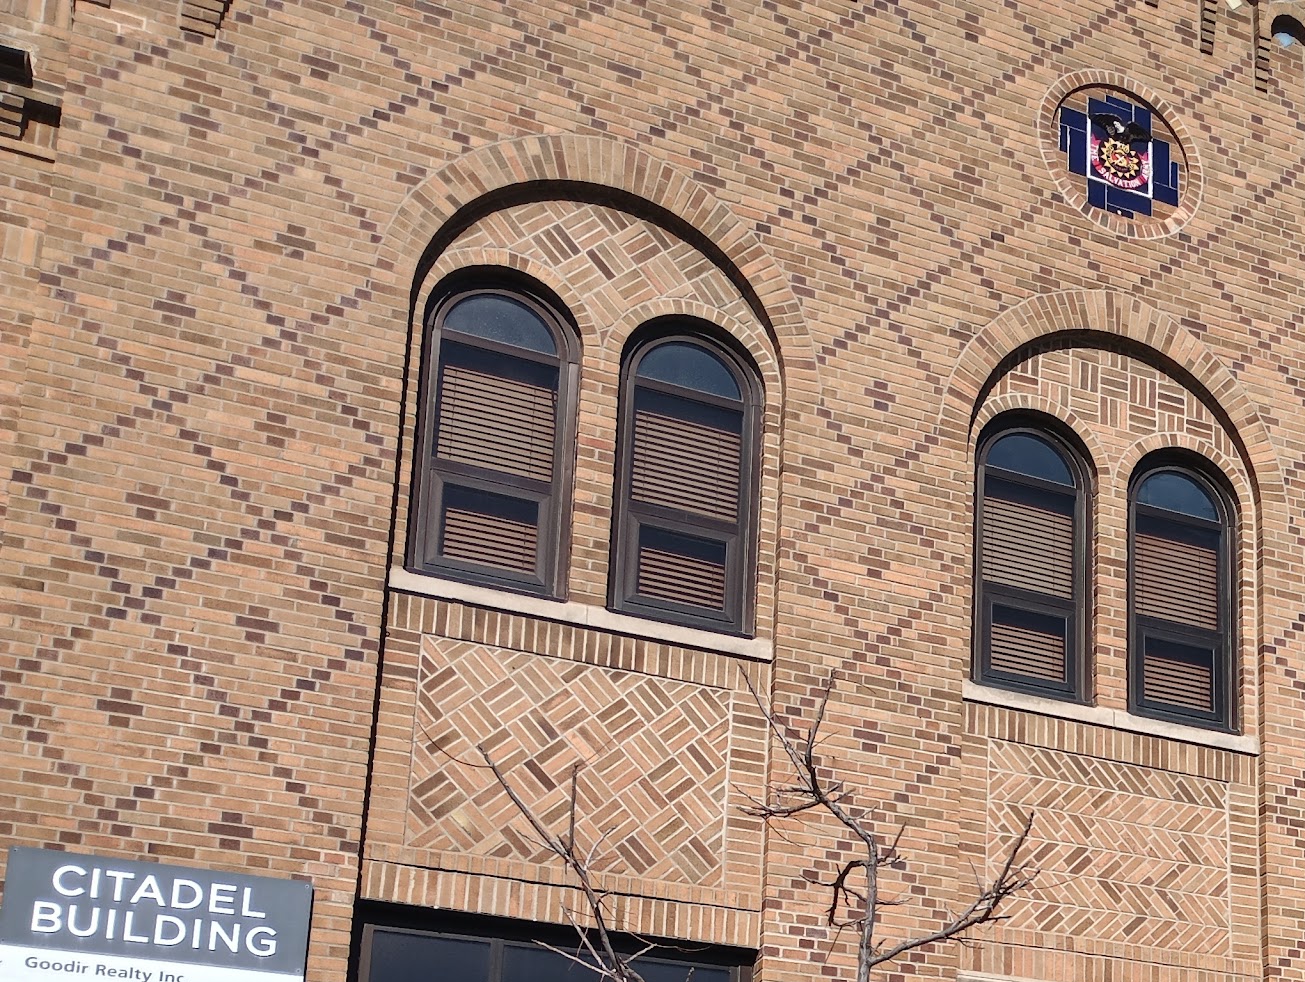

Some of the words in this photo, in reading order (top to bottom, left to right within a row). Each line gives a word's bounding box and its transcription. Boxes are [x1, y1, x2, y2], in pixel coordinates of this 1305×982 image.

[1100, 167, 1141, 188] SALVATION
[52, 865, 266, 919] CITADEL
[30, 901, 277, 957] BUILDING
[25, 957, 88, 974] Goodir
[95, 965, 152, 982] Realty
